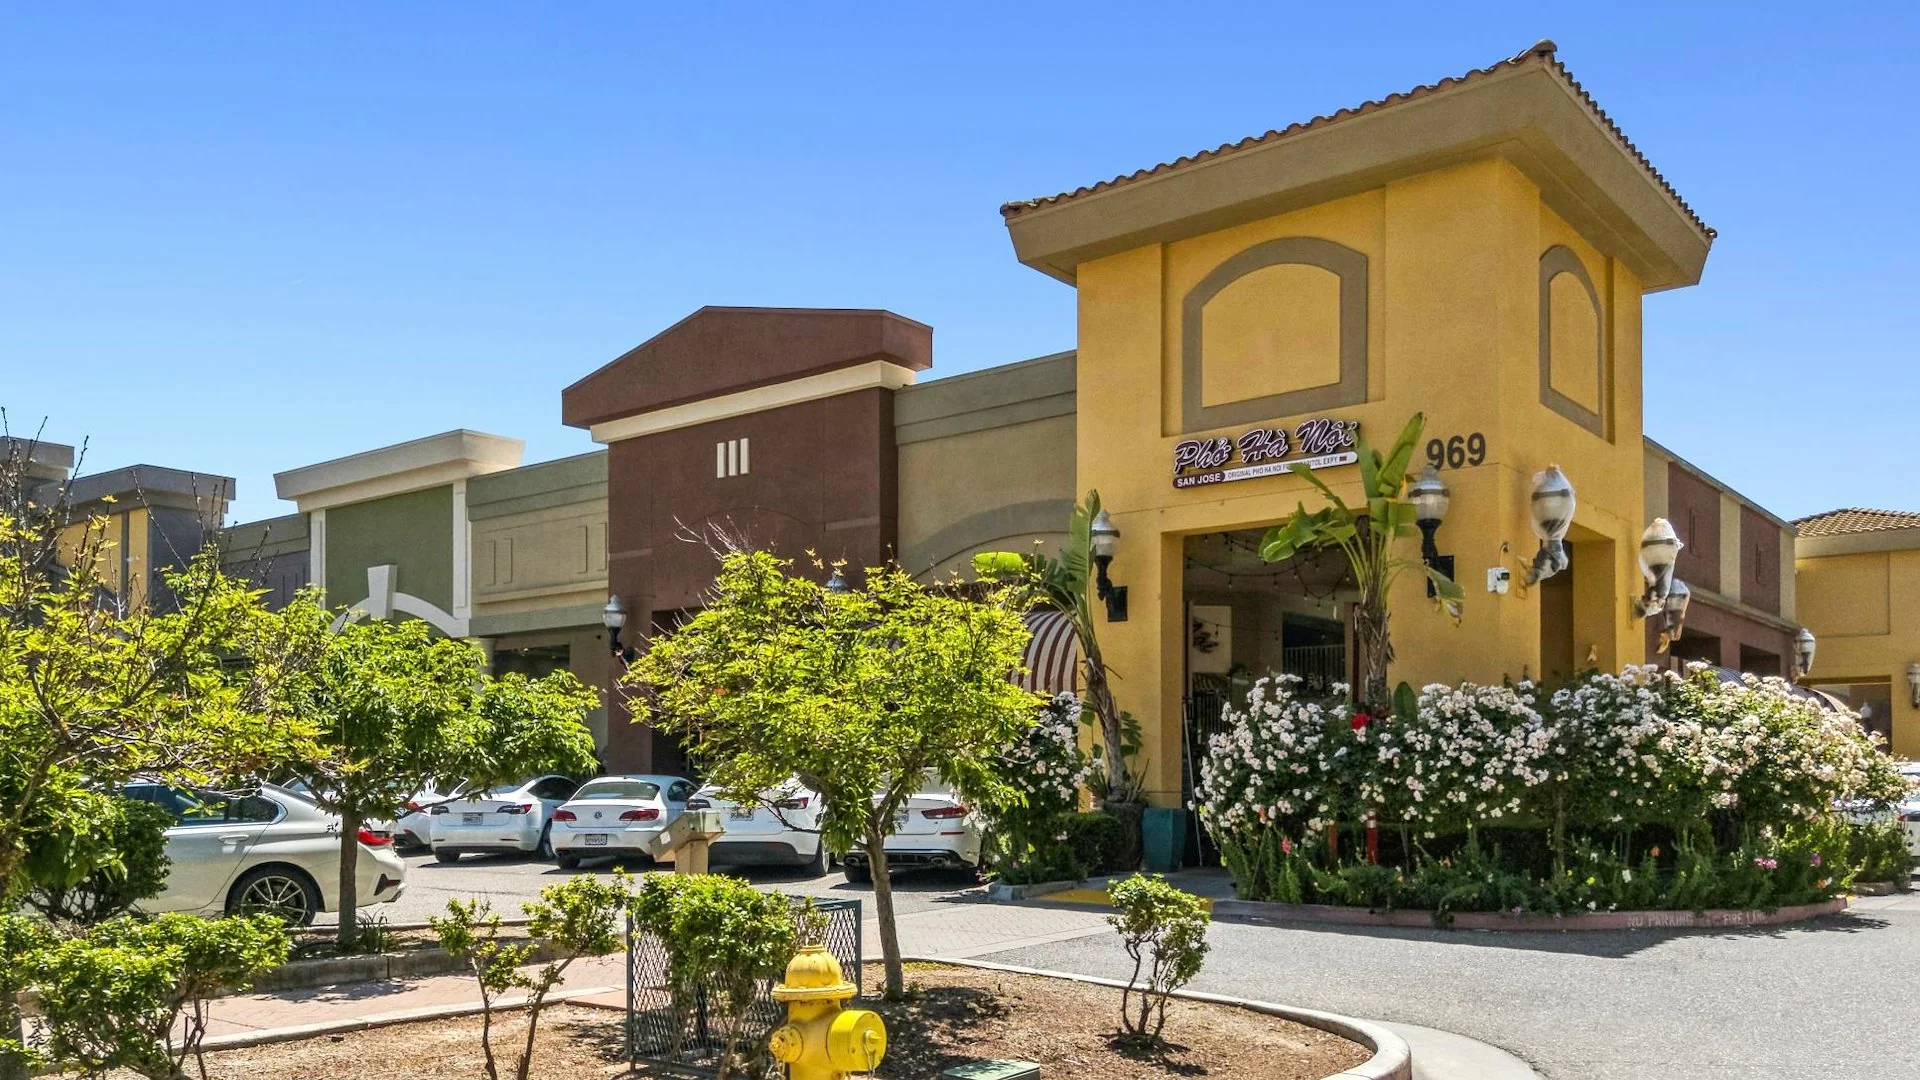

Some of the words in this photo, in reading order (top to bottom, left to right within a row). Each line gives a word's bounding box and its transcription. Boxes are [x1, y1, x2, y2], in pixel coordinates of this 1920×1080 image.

[1237, 429, 1289, 463] Hà
[1426, 432, 1486, 470] 969
[1177, 477, 1195, 488] SAN
[1198, 472, 1222, 485] JOSE
[1227, 470, 1251, 479] ORIGINAL
[1252, 466, 1264, 476] PHO
[1264, 466, 1272, 474] HA
[1273, 464, 1281, 473] NOI
[1323, 456, 1337, 466] EXPY
[1628, 915, 1644, 927] NO
[1648, 914, 1694, 927] PARKING
[1723, 912, 1743, 926] FIRE
